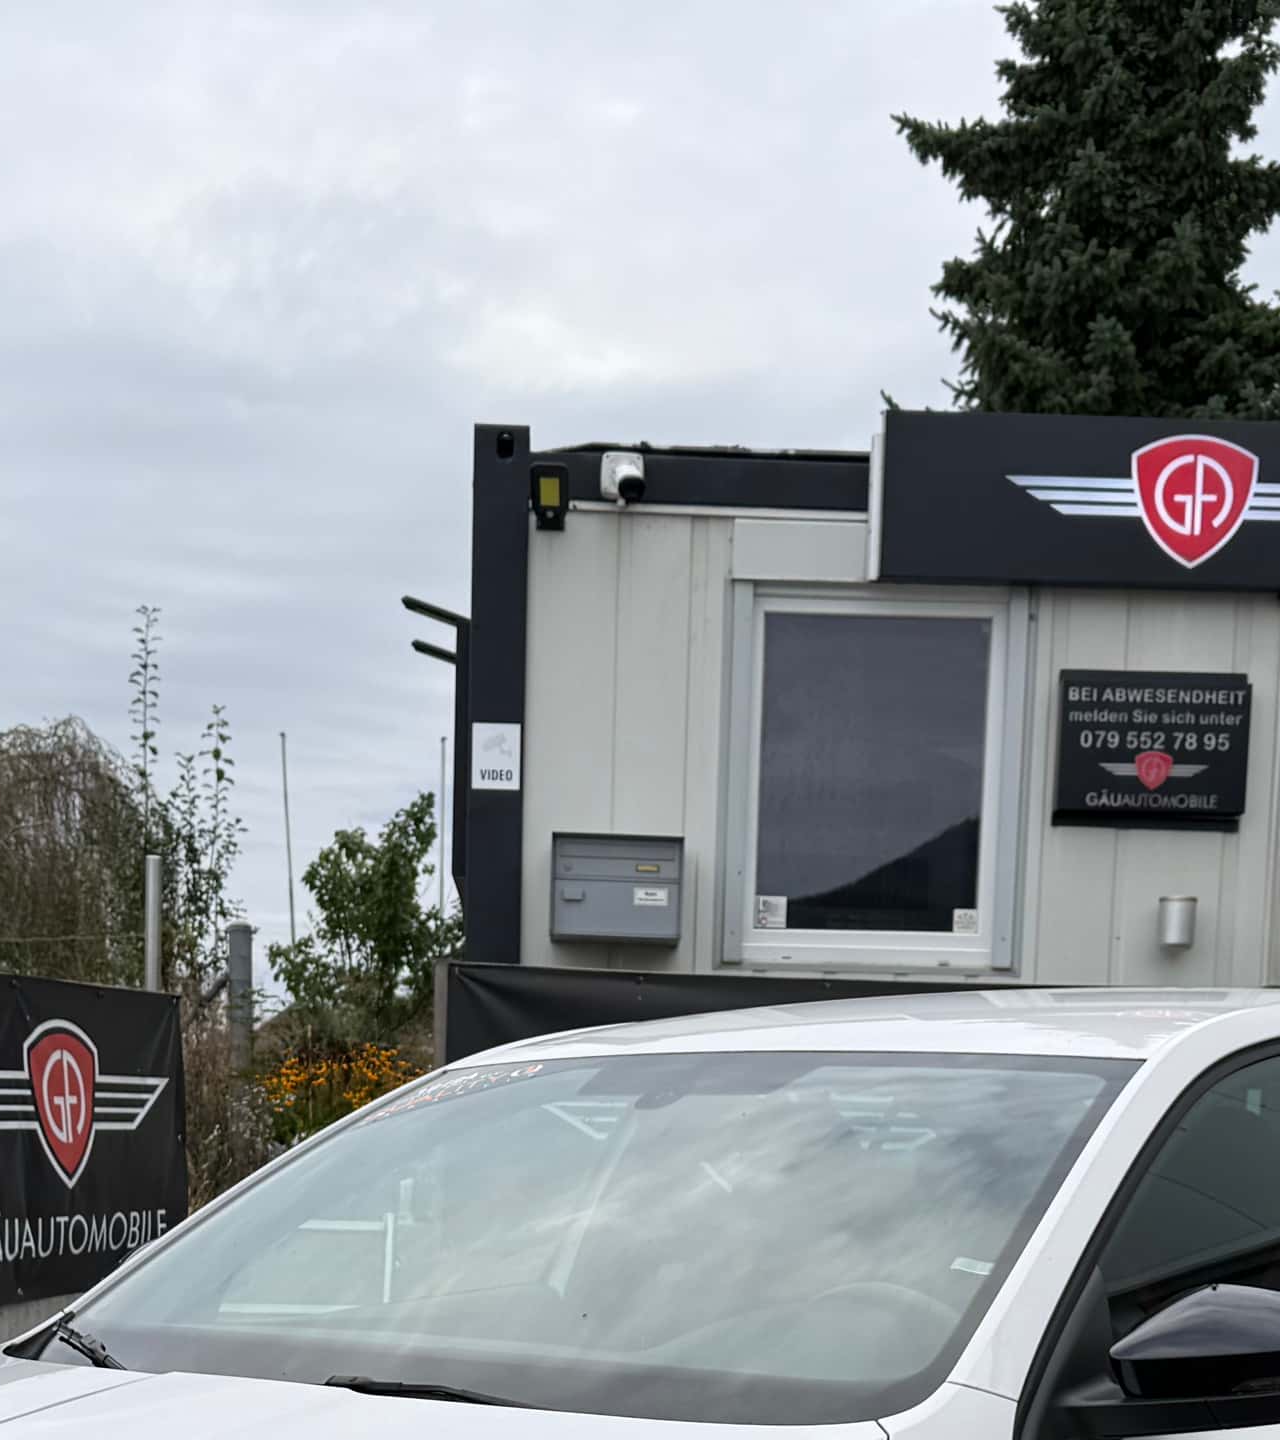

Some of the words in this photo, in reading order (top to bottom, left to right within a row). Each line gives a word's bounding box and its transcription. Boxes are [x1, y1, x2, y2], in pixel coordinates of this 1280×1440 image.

[1068, 686, 1097, 702] BEI
[1101, 687, 1246, 705] ABWESENDHEIT
[1068, 709, 1128, 723] melden
[1132, 709, 1158, 724] Sie
[1162, 710, 1195, 725] sich
[1199, 712, 1243, 726] unter
[1079, 730, 1120, 748] 079
[1126, 731, 1166, 750] 552
[1172, 732, 1198, 750] 78
[1203, 733, 1231, 751] 95
[480, 768, 513, 782] VIDEO
[1085, 789, 1218, 809] GÄUAUTOMOBILE
